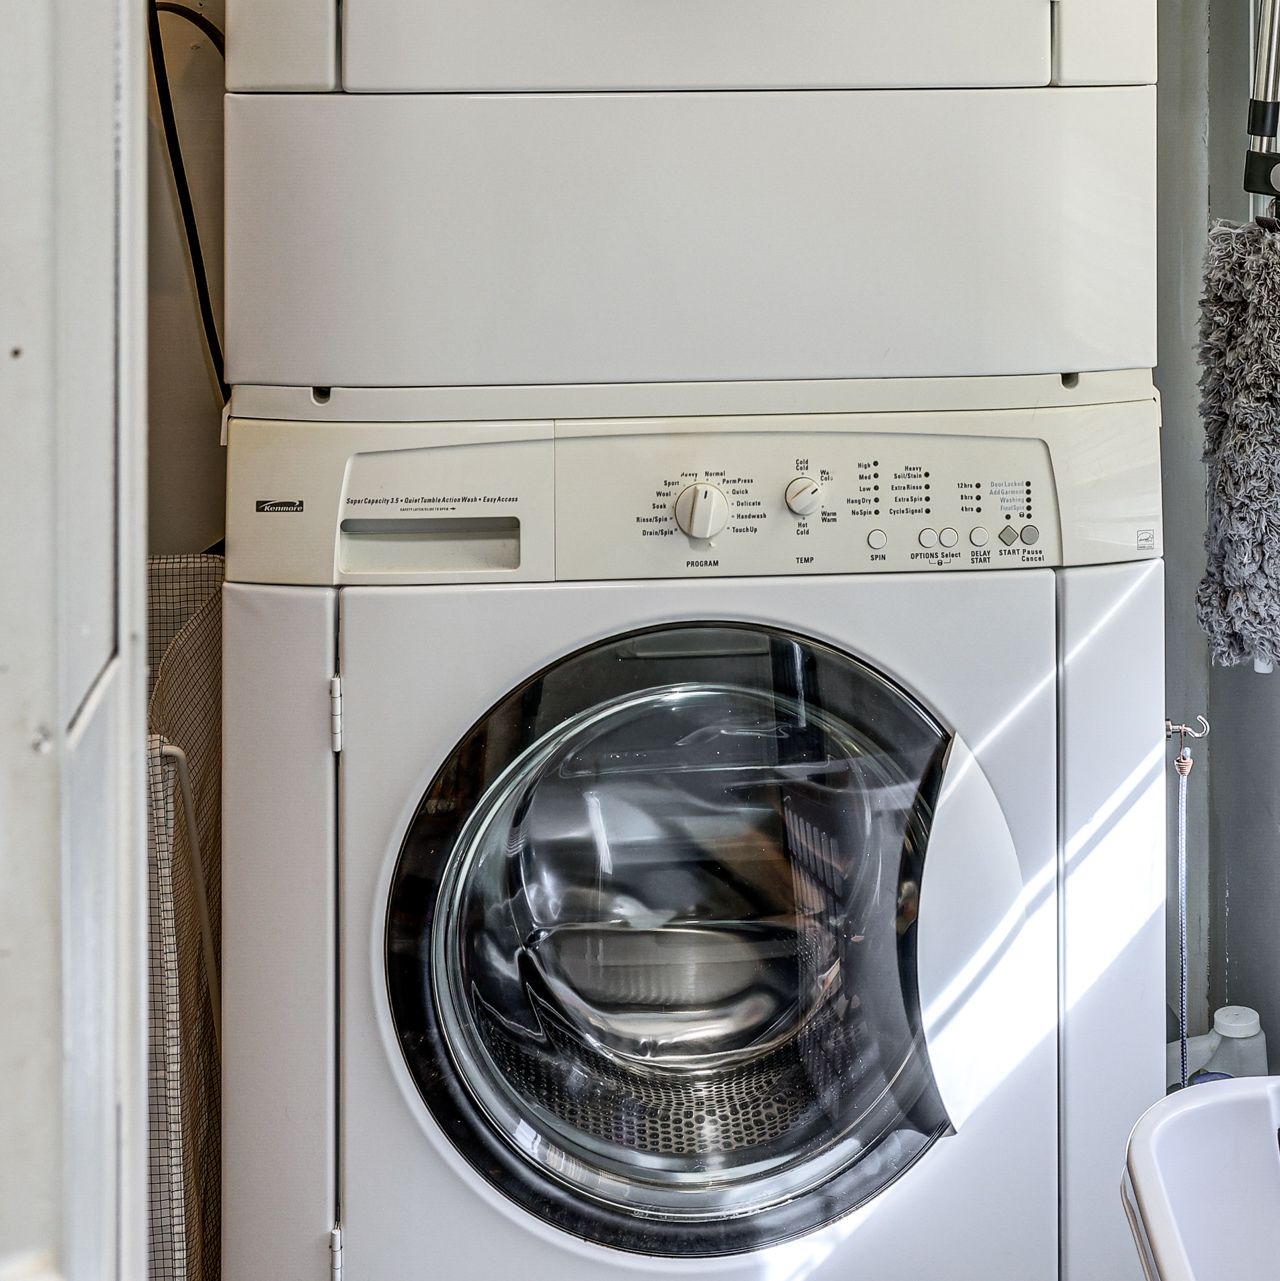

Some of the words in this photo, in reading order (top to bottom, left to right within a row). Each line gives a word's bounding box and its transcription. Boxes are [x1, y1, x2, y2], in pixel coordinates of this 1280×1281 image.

[262, 503, 303, 512] Kenmore
[796, 556, 814, 564] TEMP
[910, 552, 939, 560] OPTIONS
[940, 551, 961, 559] Select
